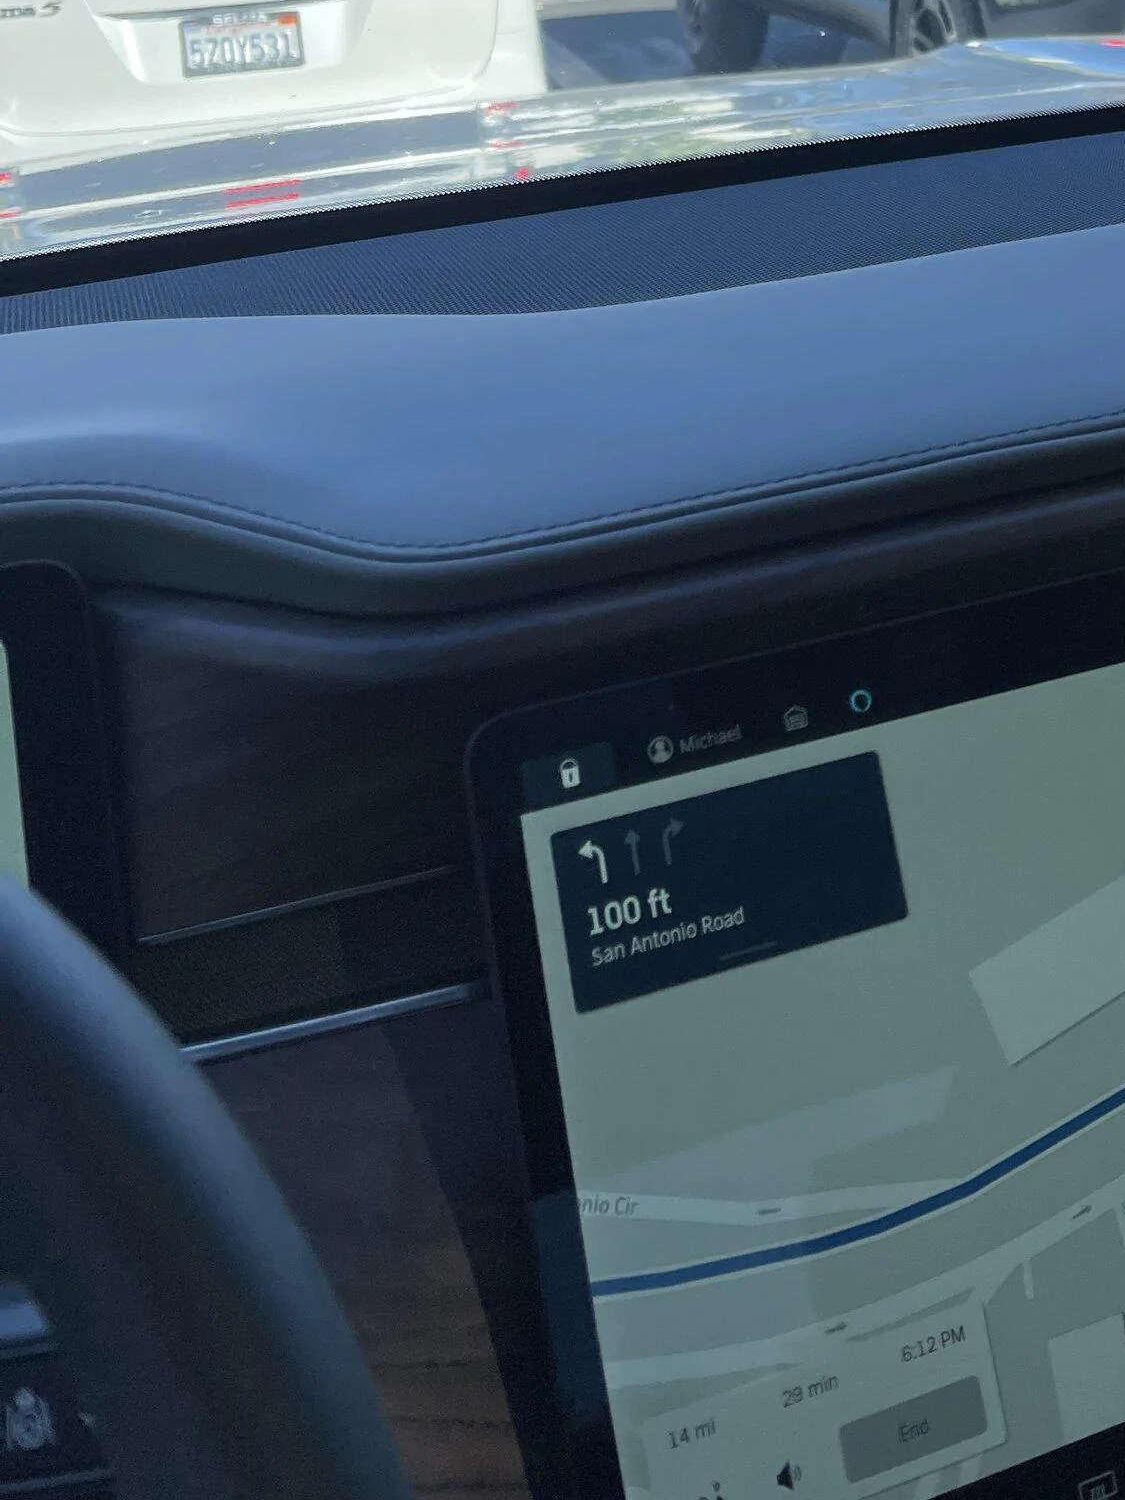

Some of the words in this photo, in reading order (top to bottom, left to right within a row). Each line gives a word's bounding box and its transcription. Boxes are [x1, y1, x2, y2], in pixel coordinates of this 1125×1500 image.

[679, 723, 743, 754] Michael
[587, 894, 642, 936] 100
[647, 887, 673, 919] ft
[591, 942, 627, 967] San
[630, 921, 698, 956] Antonio
[701, 905, 746, 935] Road
[614, 1195, 639, 1217] Cir
[901, 1335, 938, 1363] 6:12
[939, 1324, 967, 1348] PM
[807, 1374, 840, 1399] min
[668, 1426, 691, 1449] 14
[694, 1416, 717, 1441] mi
[898, 1418, 931, 1445] End
